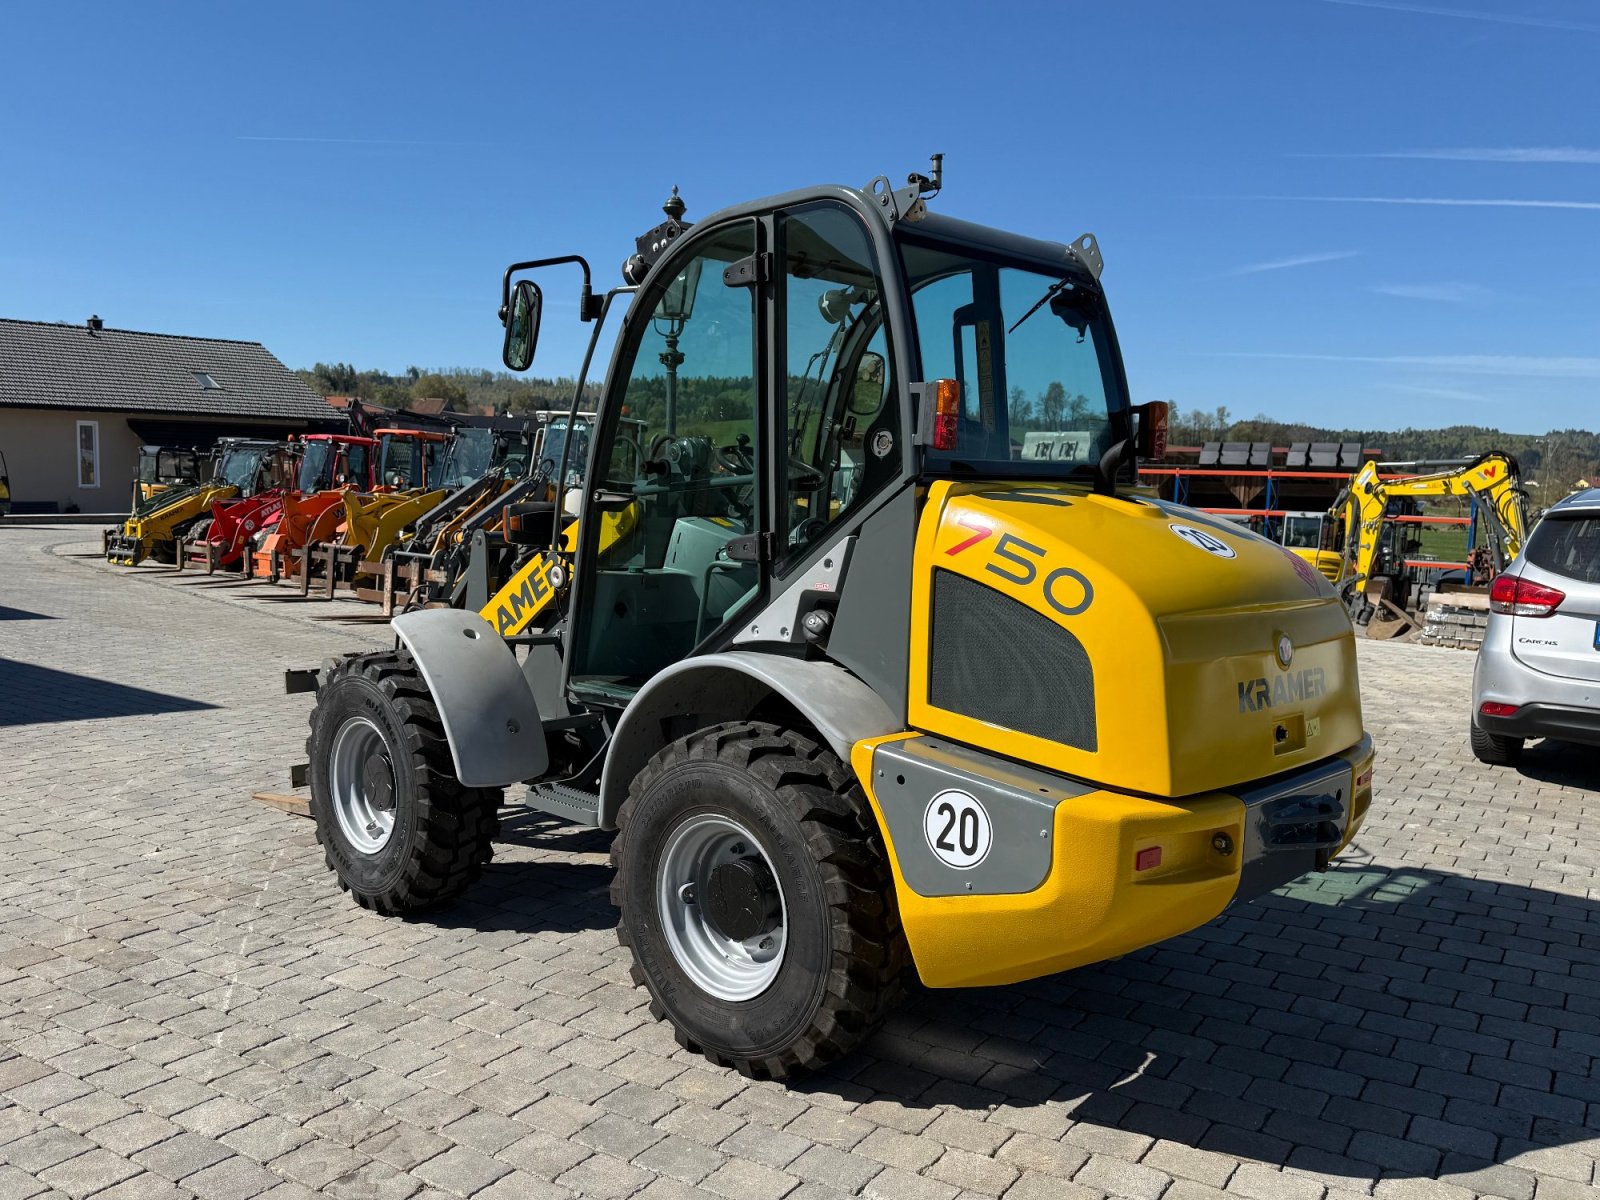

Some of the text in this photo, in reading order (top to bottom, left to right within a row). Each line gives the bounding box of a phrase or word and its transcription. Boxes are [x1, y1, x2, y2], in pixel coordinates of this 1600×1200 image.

[261, 501, 282, 518] ATLAS
[1178, 529, 1224, 552] 20
[945, 520, 1094, 616] 750
[487, 553, 560, 636] AME
[1238, 668, 1326, 713] KRAMER
[936, 803, 980, 857] 20
